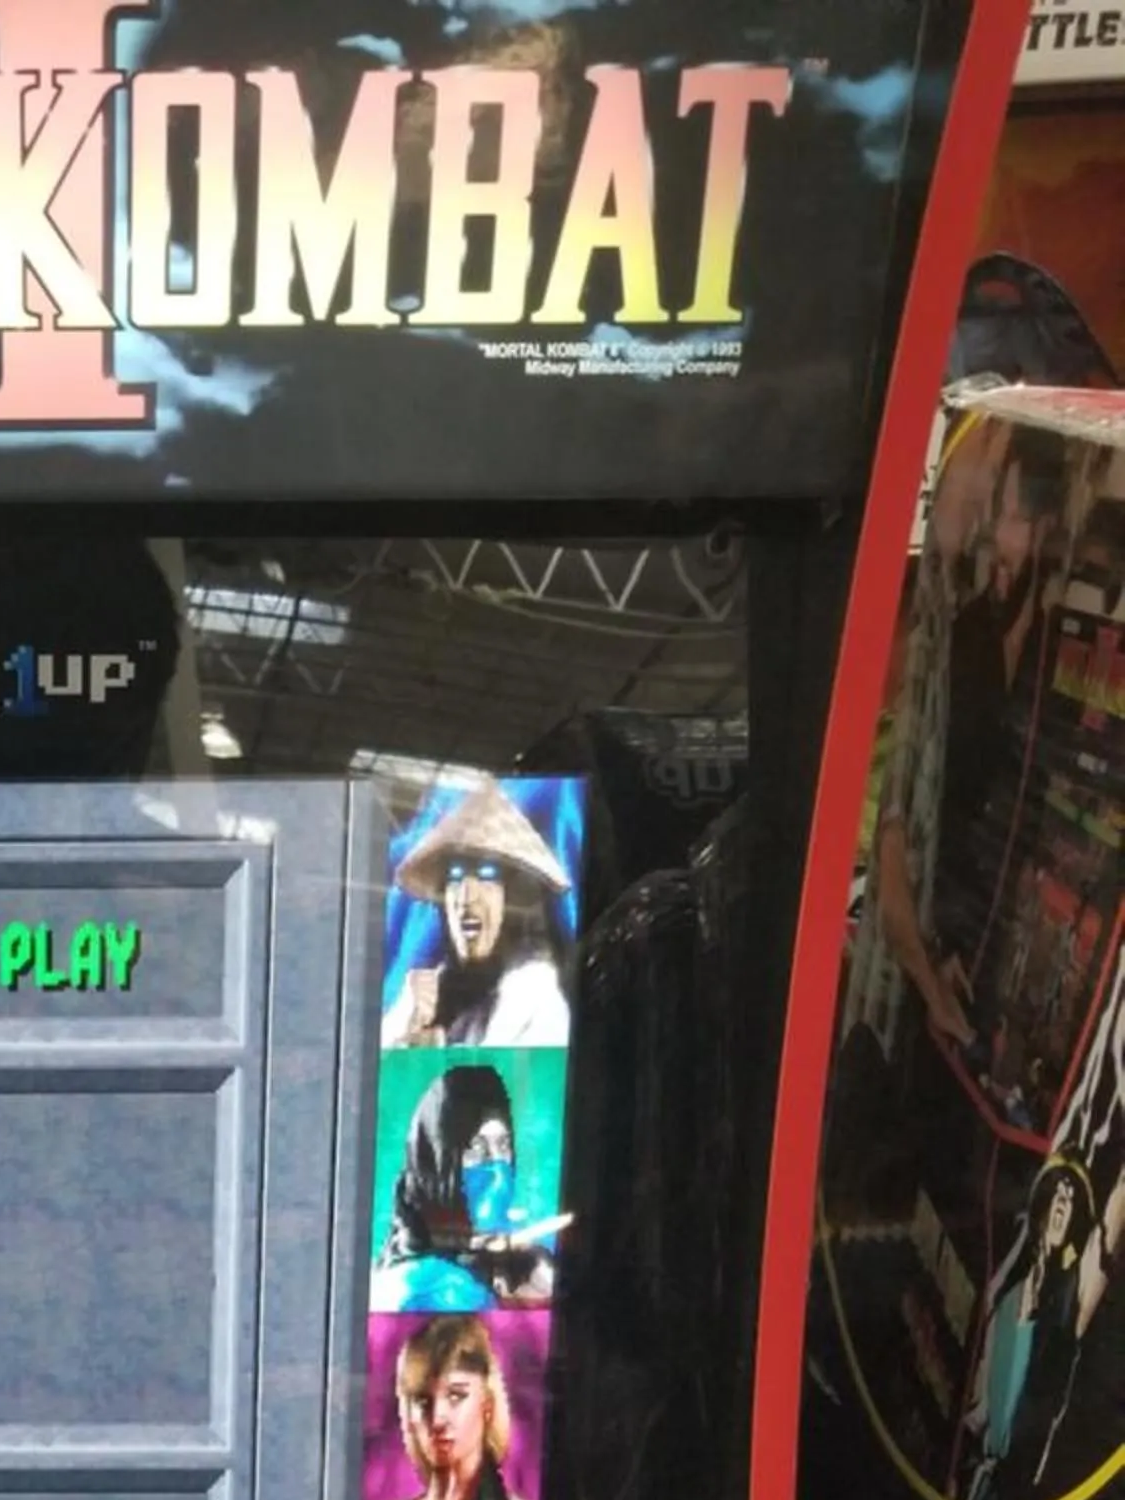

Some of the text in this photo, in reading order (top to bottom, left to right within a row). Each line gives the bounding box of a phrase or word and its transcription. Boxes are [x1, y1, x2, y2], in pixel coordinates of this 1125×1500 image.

[525, 360, 741, 377] Midway Manufacturing Company
